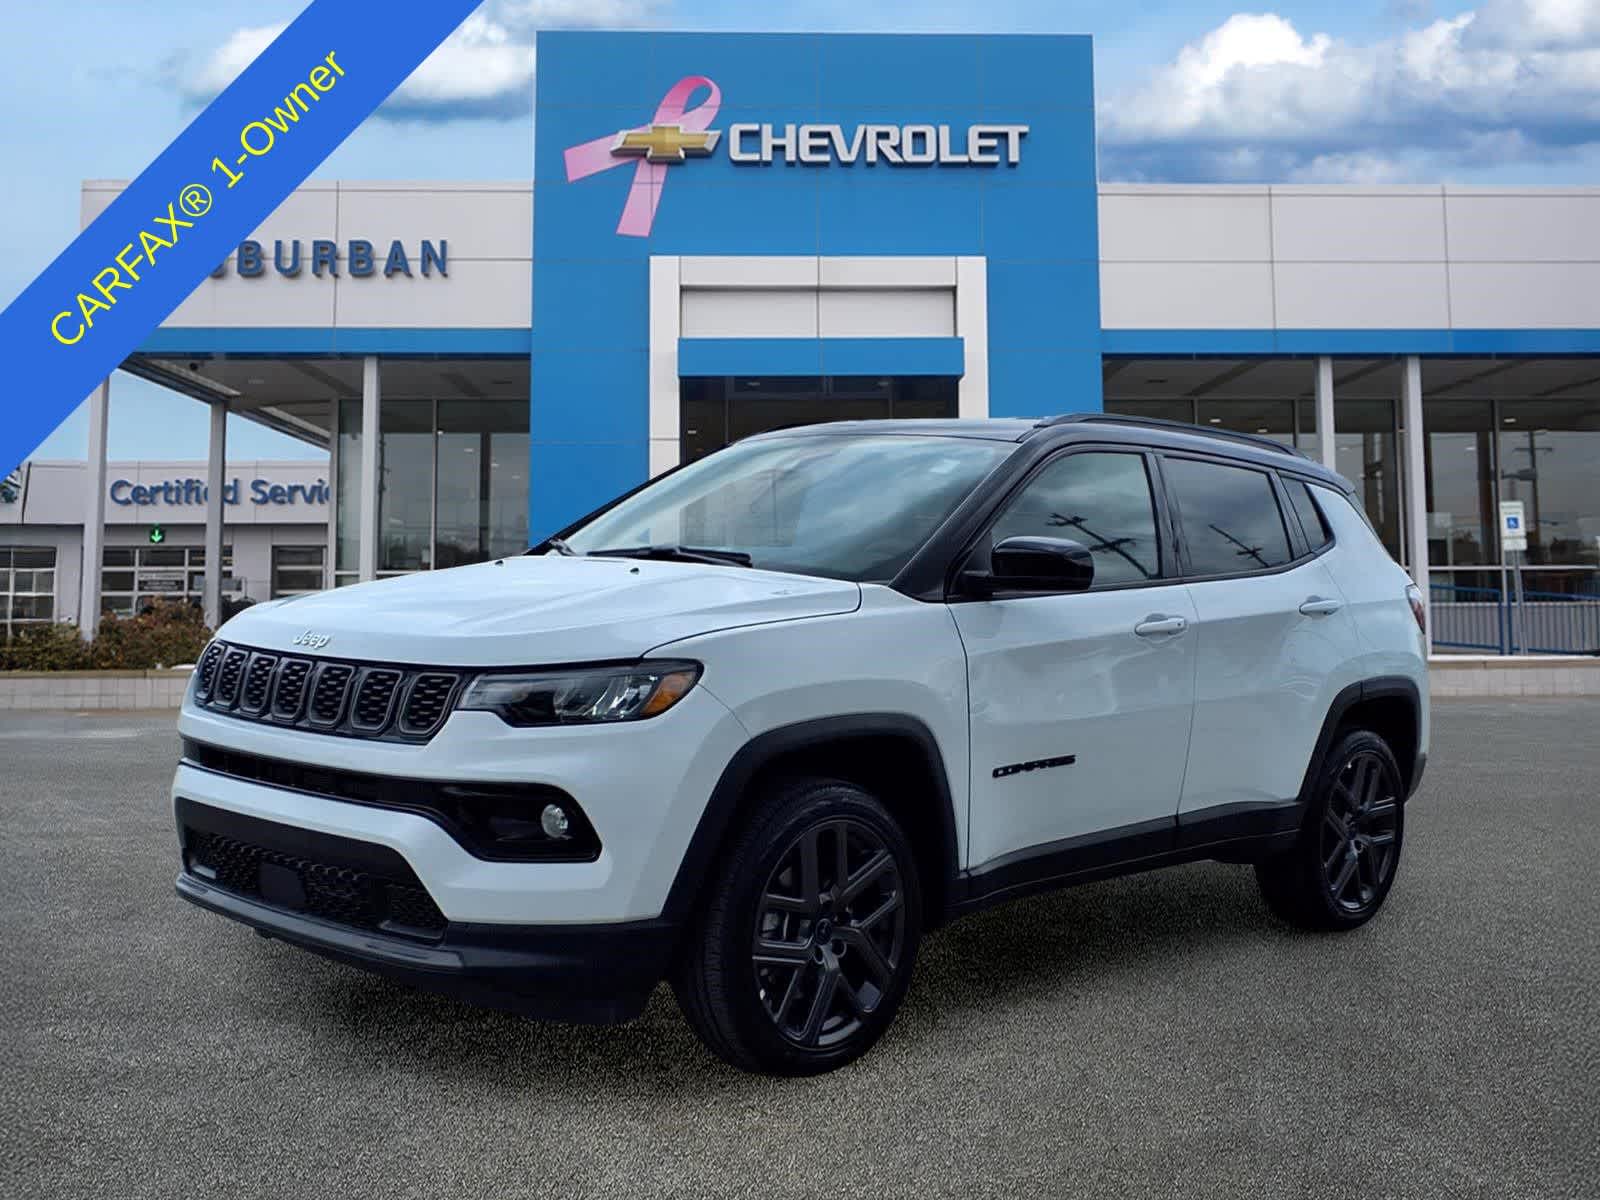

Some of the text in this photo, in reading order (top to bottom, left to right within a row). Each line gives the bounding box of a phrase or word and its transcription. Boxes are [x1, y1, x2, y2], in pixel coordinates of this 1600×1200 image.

[730, 123, 1029, 163] CHEVROLET
[209, 239, 449, 277] BURBAN
[110, 479, 330, 505] Certifid Servi
[293, 630, 331, 649] Jeep
